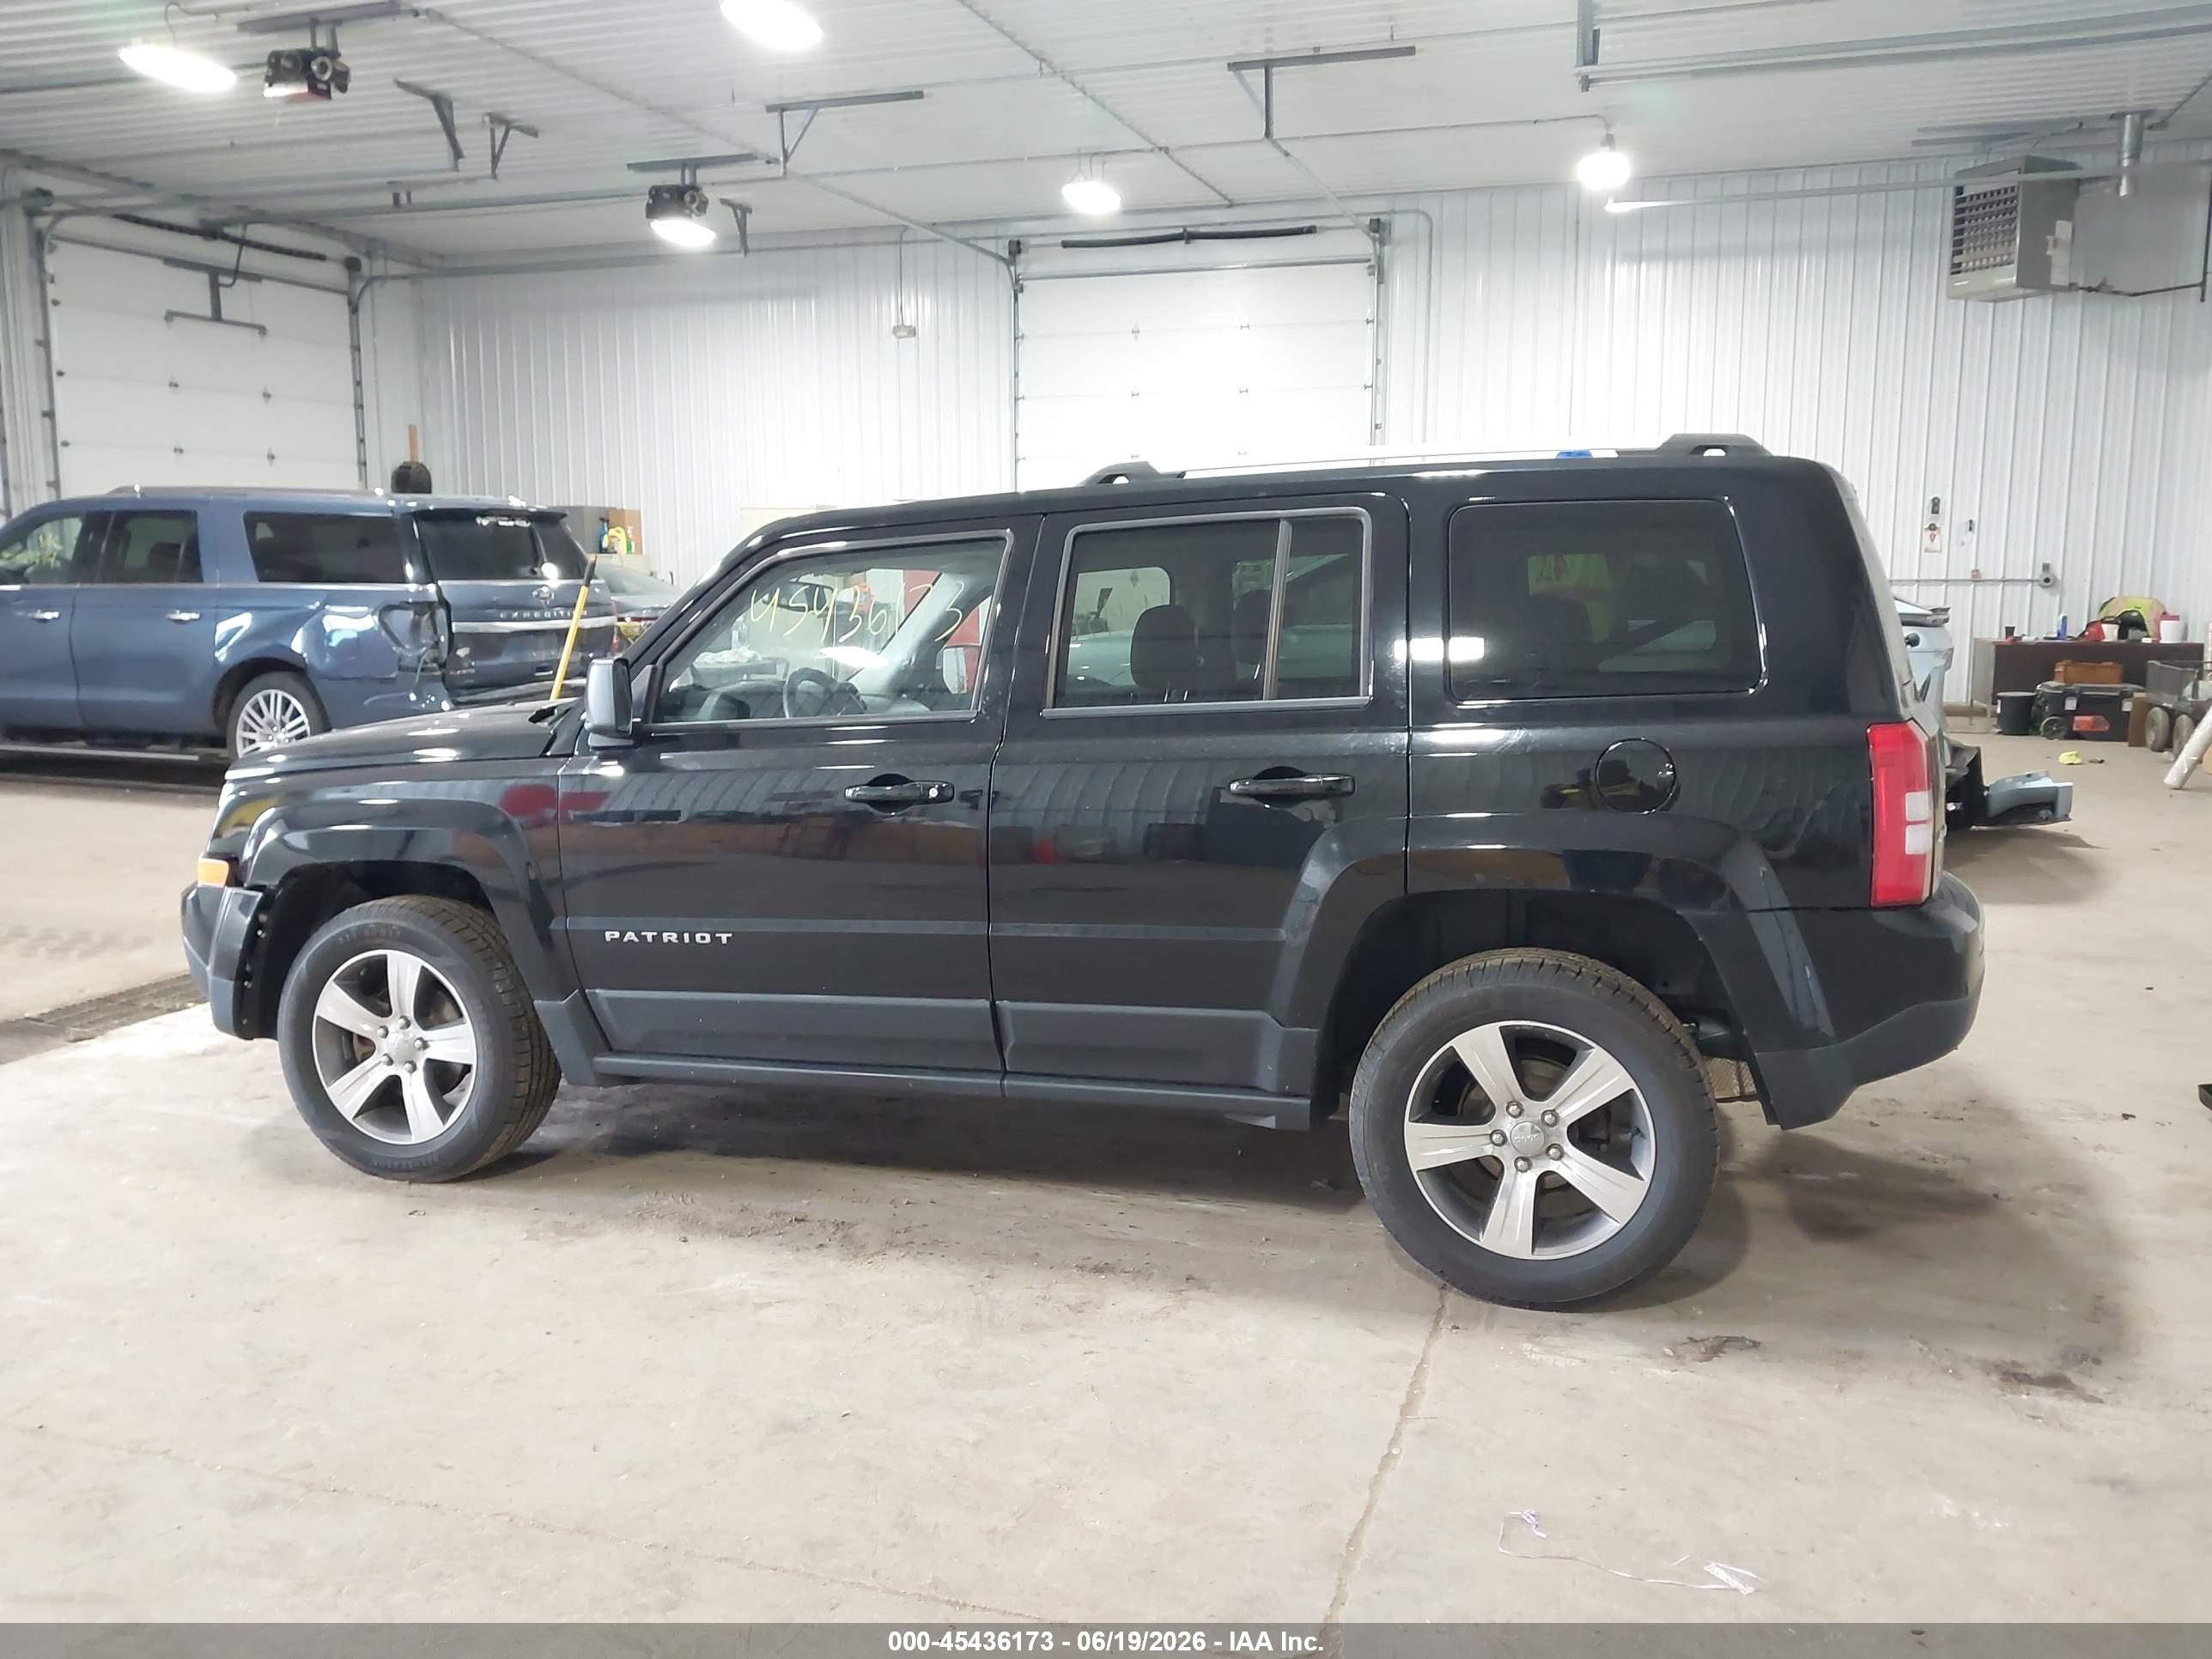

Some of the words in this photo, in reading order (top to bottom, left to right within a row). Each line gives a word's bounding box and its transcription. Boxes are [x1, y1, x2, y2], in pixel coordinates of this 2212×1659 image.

[499, 610, 588, 619] EXPEDITIN
[750, 580, 965, 642] 45436173
[605, 930, 733, 945] PATRIOT
